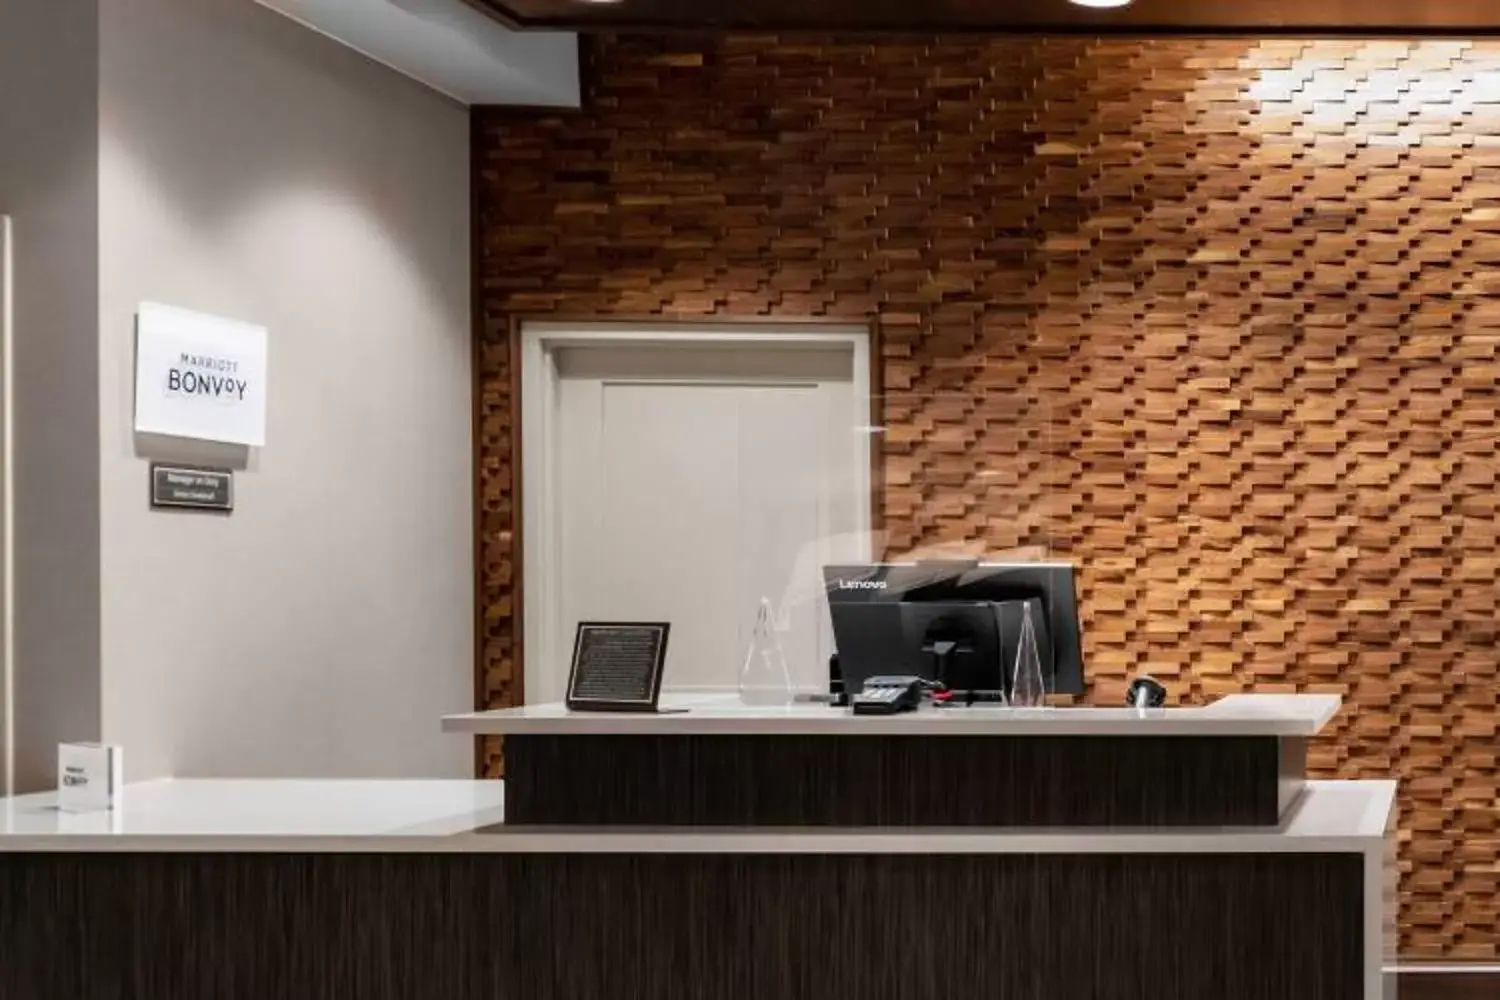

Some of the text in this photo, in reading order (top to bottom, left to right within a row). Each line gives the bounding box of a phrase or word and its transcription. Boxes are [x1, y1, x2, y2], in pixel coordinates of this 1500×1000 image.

[181, 352, 238, 373] MARRIOTT
[168, 368, 247, 401] BONVOY
[839, 579, 887, 589] Lenovo
